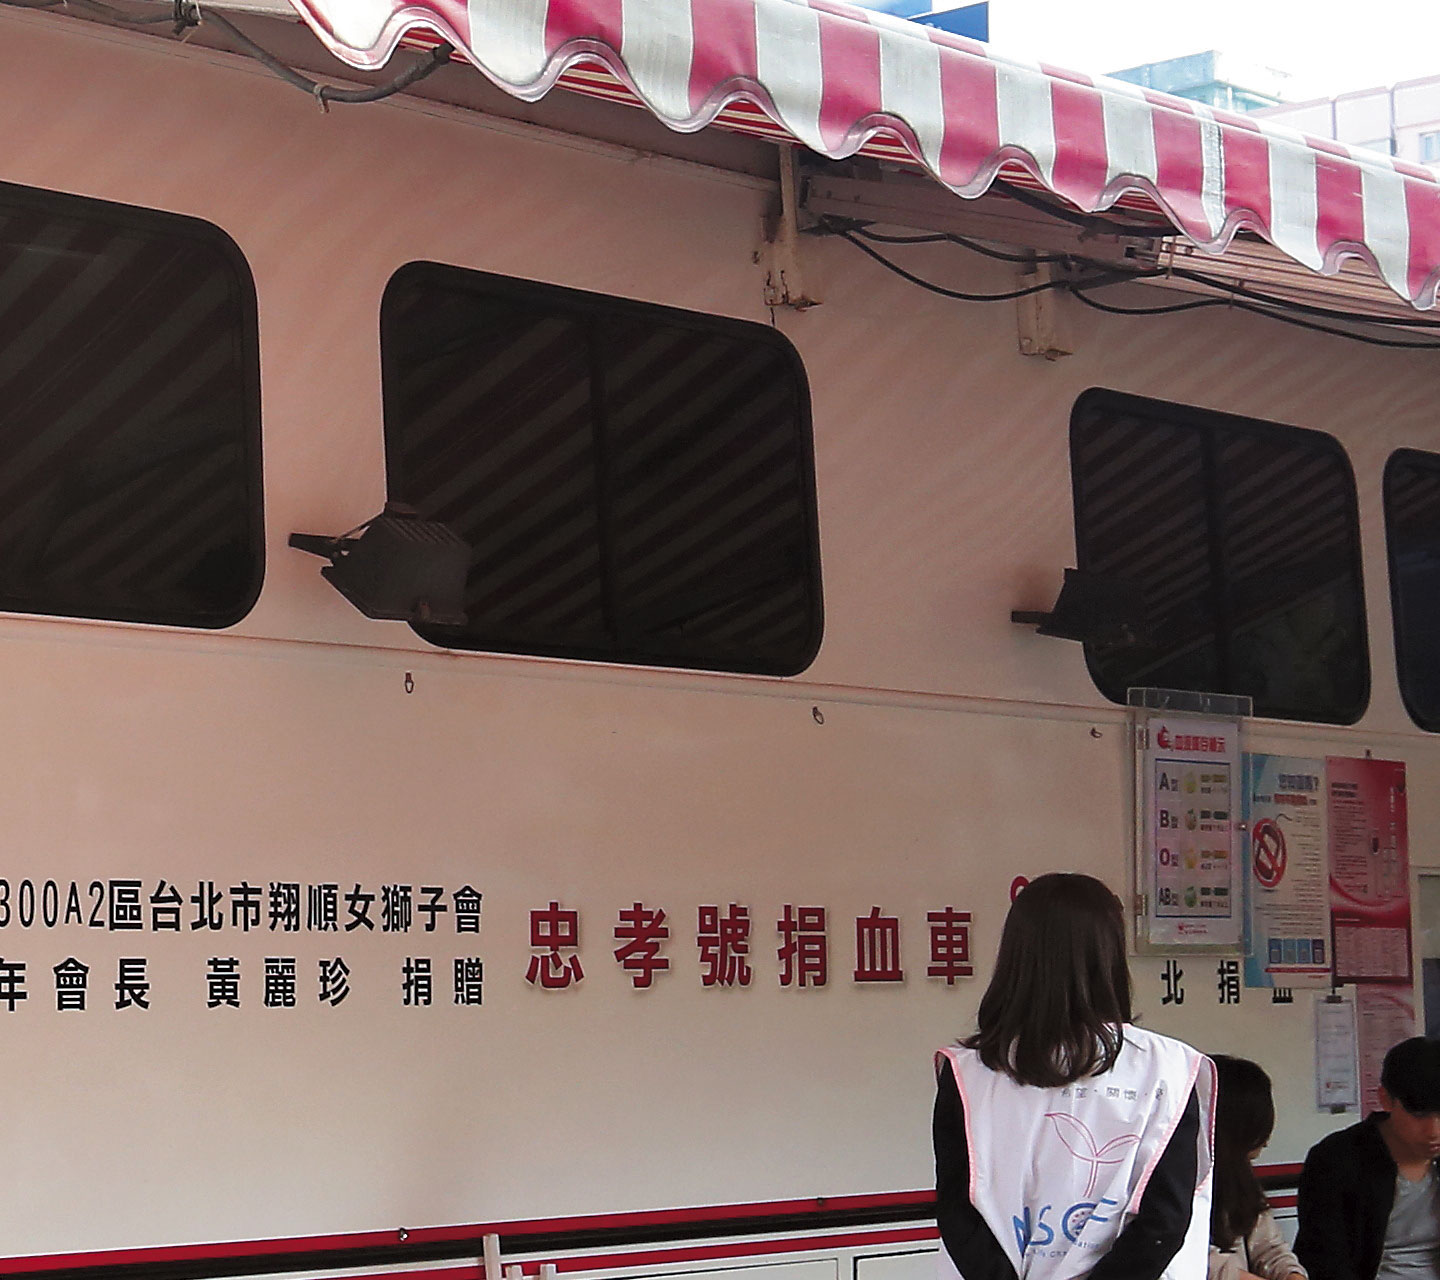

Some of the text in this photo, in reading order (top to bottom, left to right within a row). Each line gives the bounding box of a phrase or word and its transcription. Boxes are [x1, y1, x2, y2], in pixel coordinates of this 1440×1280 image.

[525, 899, 975, 990] 忠孝號捐血車
